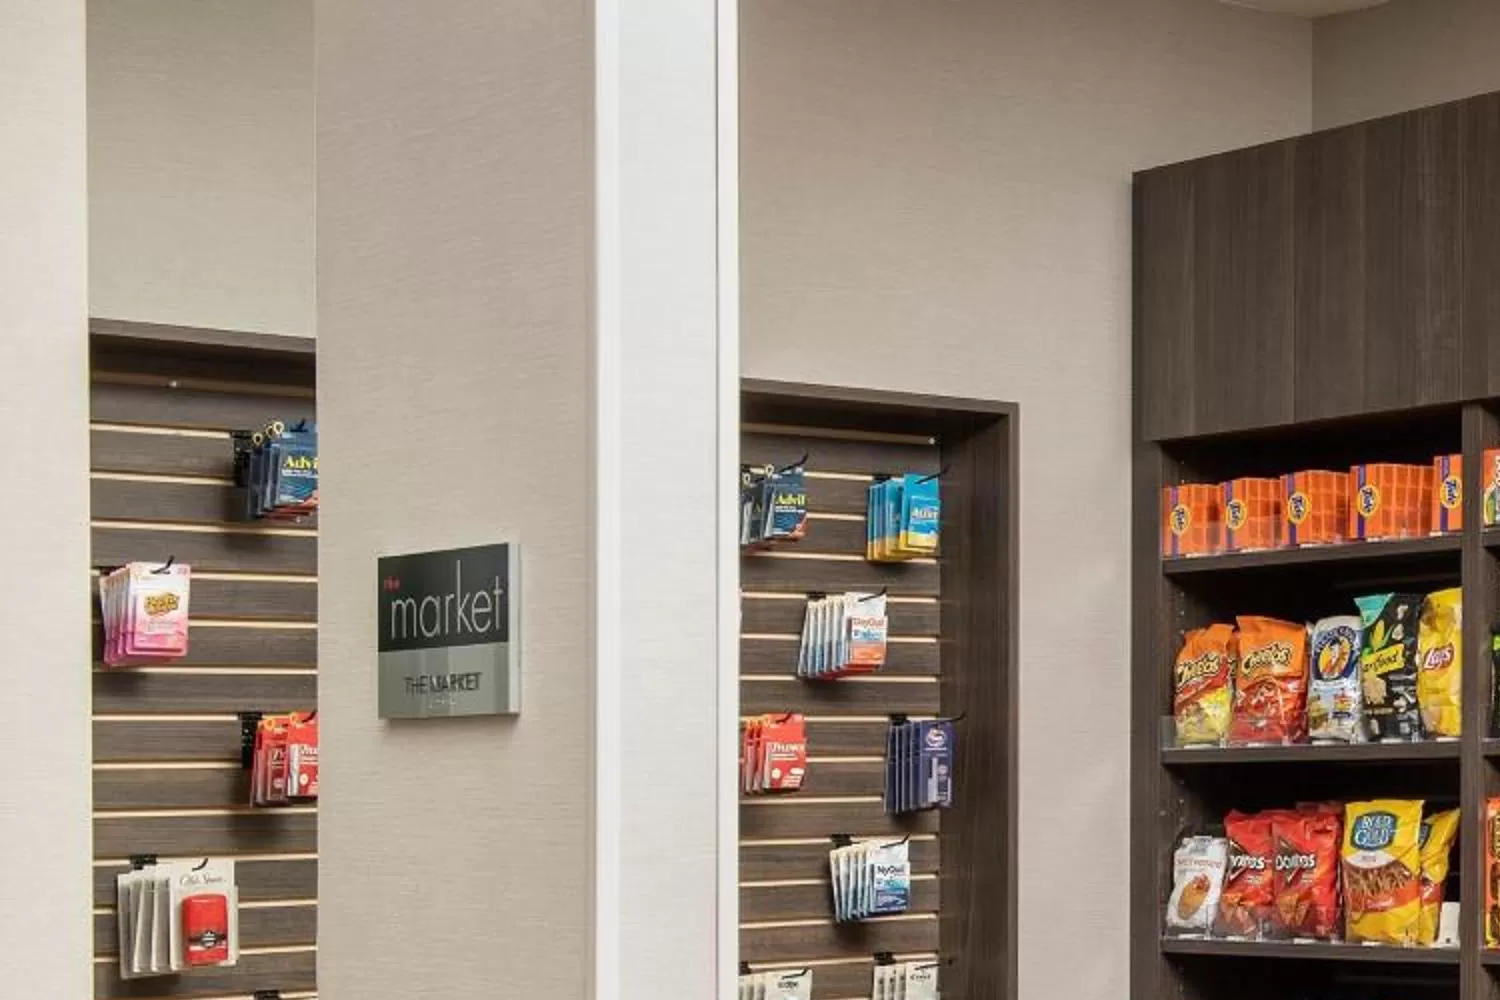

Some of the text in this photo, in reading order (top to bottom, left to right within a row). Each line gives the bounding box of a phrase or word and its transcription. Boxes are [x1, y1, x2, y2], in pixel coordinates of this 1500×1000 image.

[283, 456, 318, 468] Advi
[391, 559, 504, 640] market
[404, 671, 482, 695] THE MARKET
